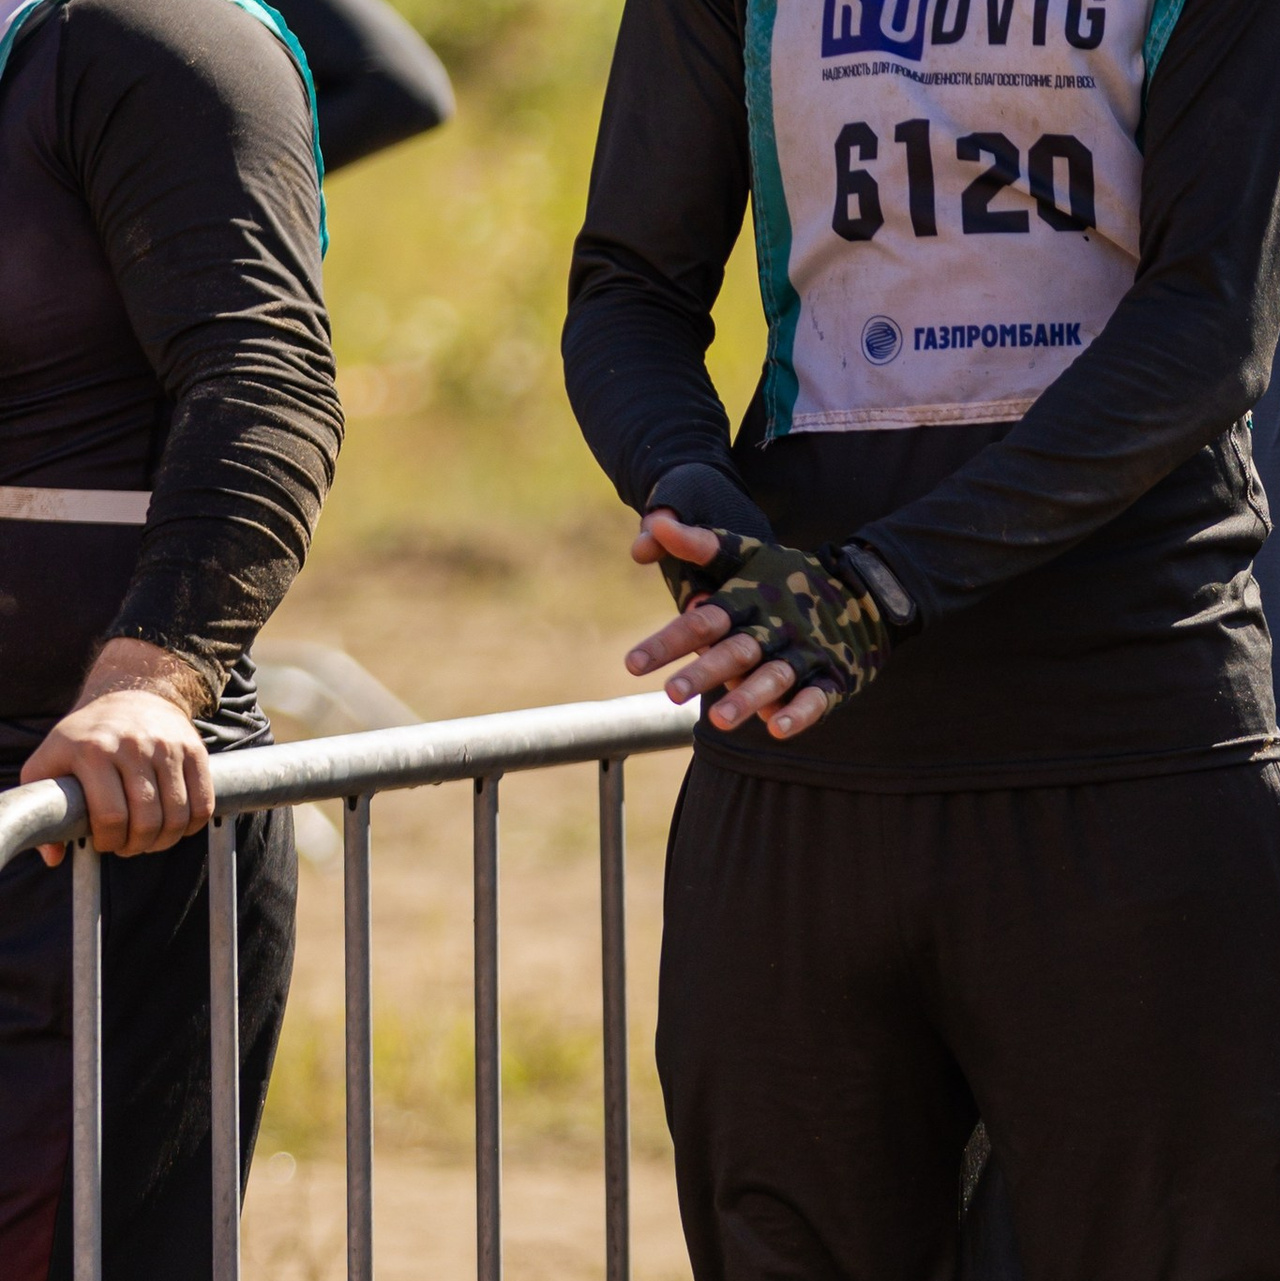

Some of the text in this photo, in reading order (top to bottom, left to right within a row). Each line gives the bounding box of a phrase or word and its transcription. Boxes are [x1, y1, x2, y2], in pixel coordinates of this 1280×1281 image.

[822, 62, 871, 81] НАДЕЖНОСТЬ
[872, 61, 890, 75] ДЛЯ
[974, 72, 1053, 87] БЛАГОСОСТОЯНИЕ
[1054, 74, 1075, 89] ДЛЯ
[1077, 75, 1097, 88] ВСЕХ
[832, 118, 1097, 241] 6120
[914, 322, 1082, 351] ГАЗПРОМБАНК
